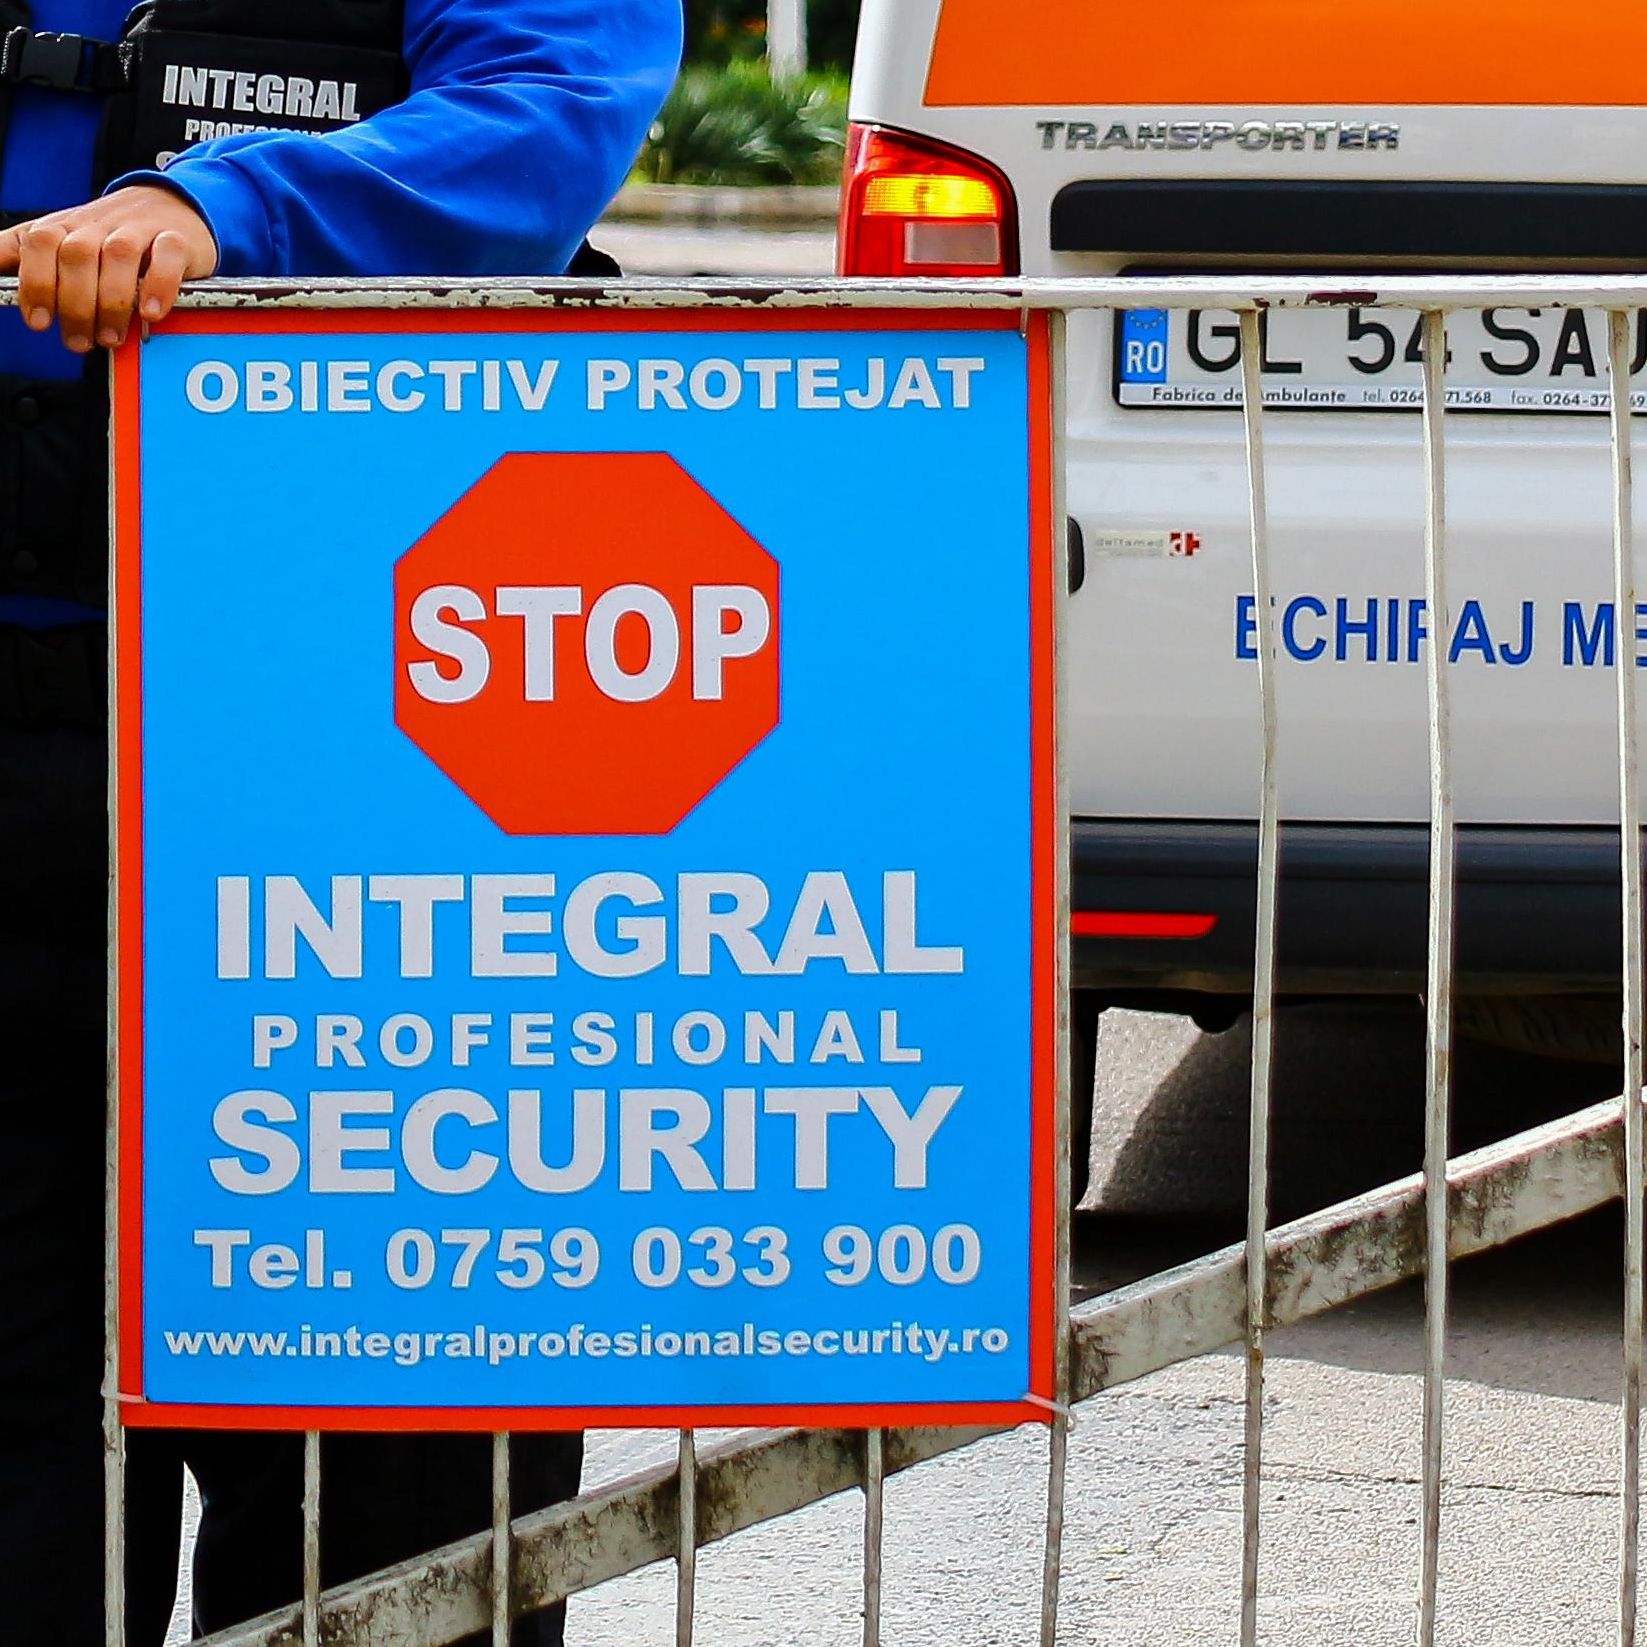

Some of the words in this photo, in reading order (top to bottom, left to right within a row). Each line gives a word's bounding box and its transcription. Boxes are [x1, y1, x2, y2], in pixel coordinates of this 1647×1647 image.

[162, 64, 361, 122] INTEGRAL
[1034, 119, 1402, 152] TRANSPORTER
[1126, 340, 1164, 374] RO
[1187, 308, 1303, 374] GL
[1347, 306, 1452, 375] 54
[184, 358, 560, 414] OBIECTIV
[585, 356, 985, 413] PROTEJAT
[1152, 386, 1216, 402] Fabrica
[1223, 386, 1244, 402] de
[1262, 387, 1347, 405] mbulanțe
[406, 583, 771, 704] STOP
[1235, 594, 1536, 666] ECHIPAJ
[215, 870, 965, 980] INTEGRAL
[252, 1009, 923, 1068] PROFESIONAL
[208, 1084, 964, 1195] SECURITY
[193, 1229, 352, 1289] Tel.
[385, 1227, 602, 1290] 0759
[631, 1225, 791, 1289] 033
[823, 1222, 982, 1288] 900
[163, 1322, 1009, 1367] www.integralprofesionalsecurity.ro
